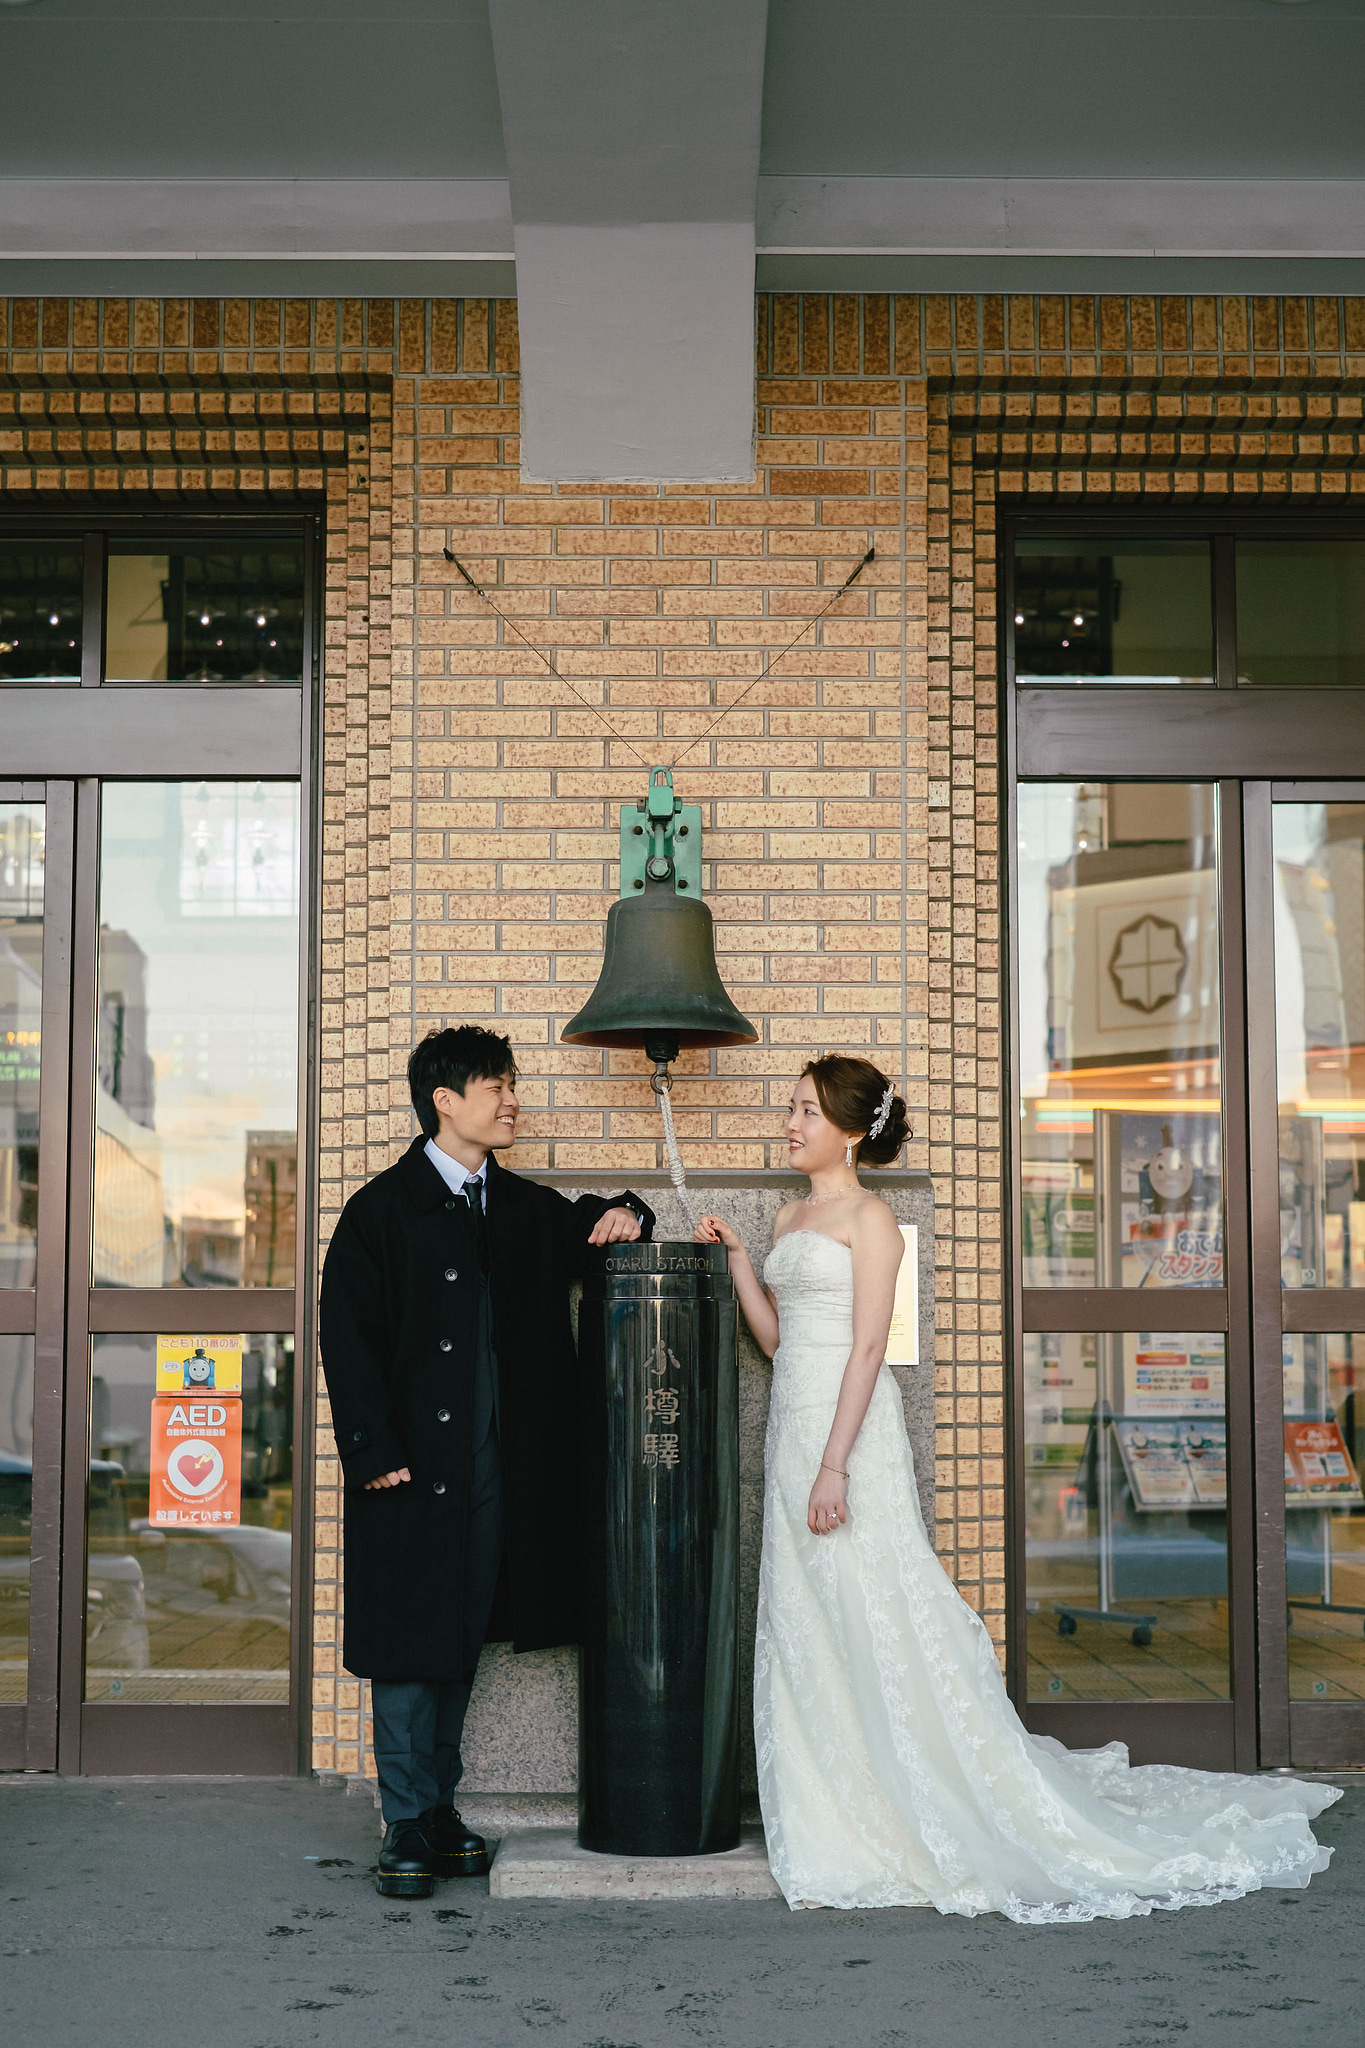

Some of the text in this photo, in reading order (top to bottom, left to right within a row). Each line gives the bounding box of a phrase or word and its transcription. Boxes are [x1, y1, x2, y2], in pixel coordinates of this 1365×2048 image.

[605, 1257, 714, 1271] OTARU STATION
[160, 1338, 239, 1349] こども110番の駅
[166, 1404, 227, 1427] AED
[156, 1509, 234, 1521] 設置しています
